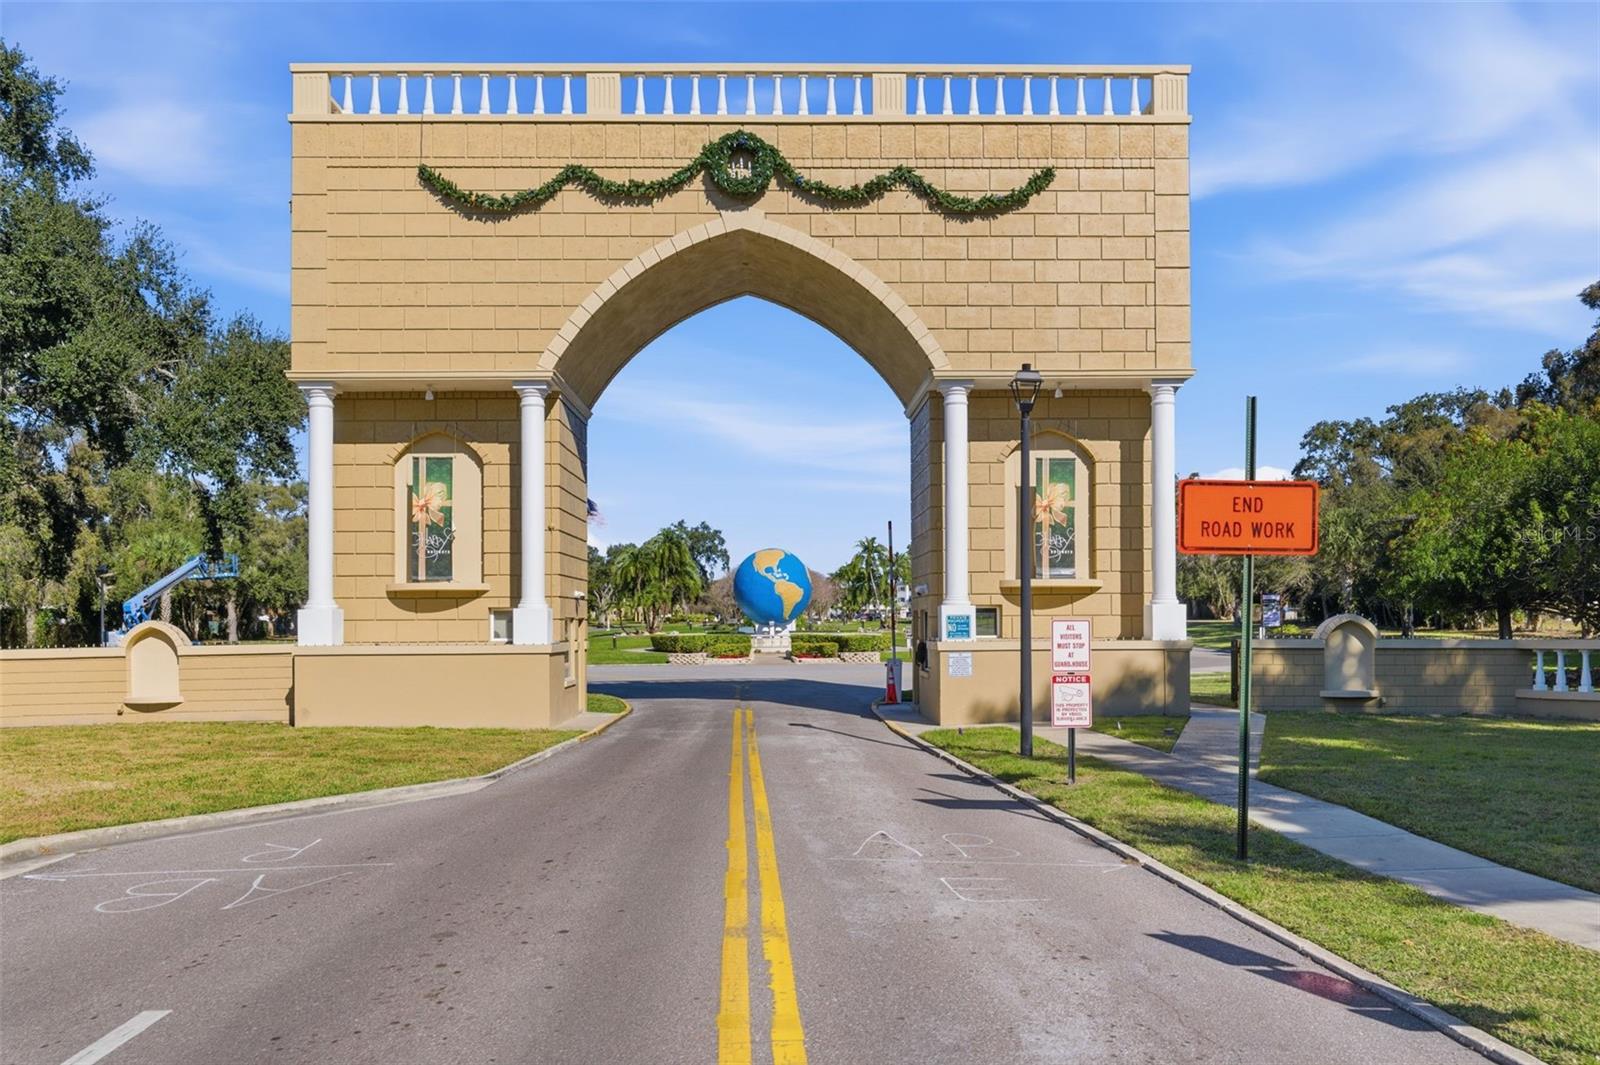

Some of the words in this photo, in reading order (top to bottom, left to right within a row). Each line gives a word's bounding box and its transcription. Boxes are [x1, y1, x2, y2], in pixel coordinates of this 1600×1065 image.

[1232, 496, 1263, 513] END
[1201, 521, 1242, 538] ROAD
[1251, 521, 1295, 538] WORK
